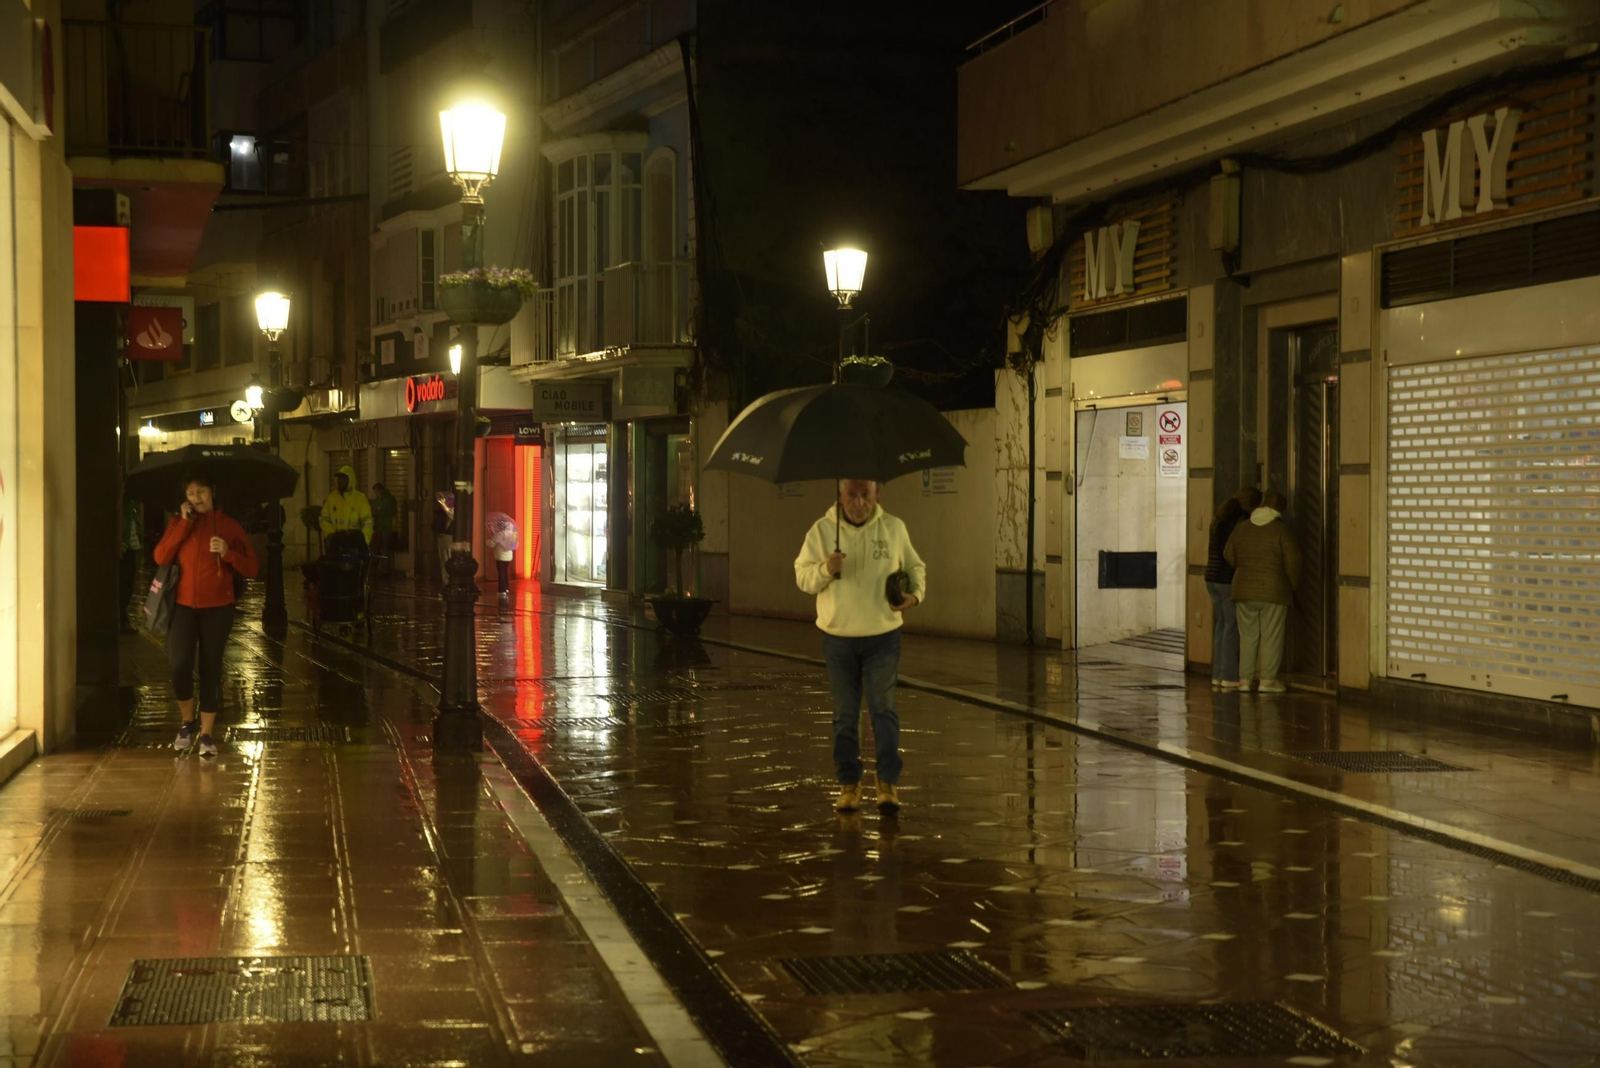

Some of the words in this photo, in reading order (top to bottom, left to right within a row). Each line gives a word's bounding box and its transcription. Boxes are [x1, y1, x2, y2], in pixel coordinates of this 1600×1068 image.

[1420, 107, 1515, 226] MY
[1084, 221, 1140, 301] MY
[555, 401, 594, 411] MOBILE
[518, 426, 540, 435] LOWI
